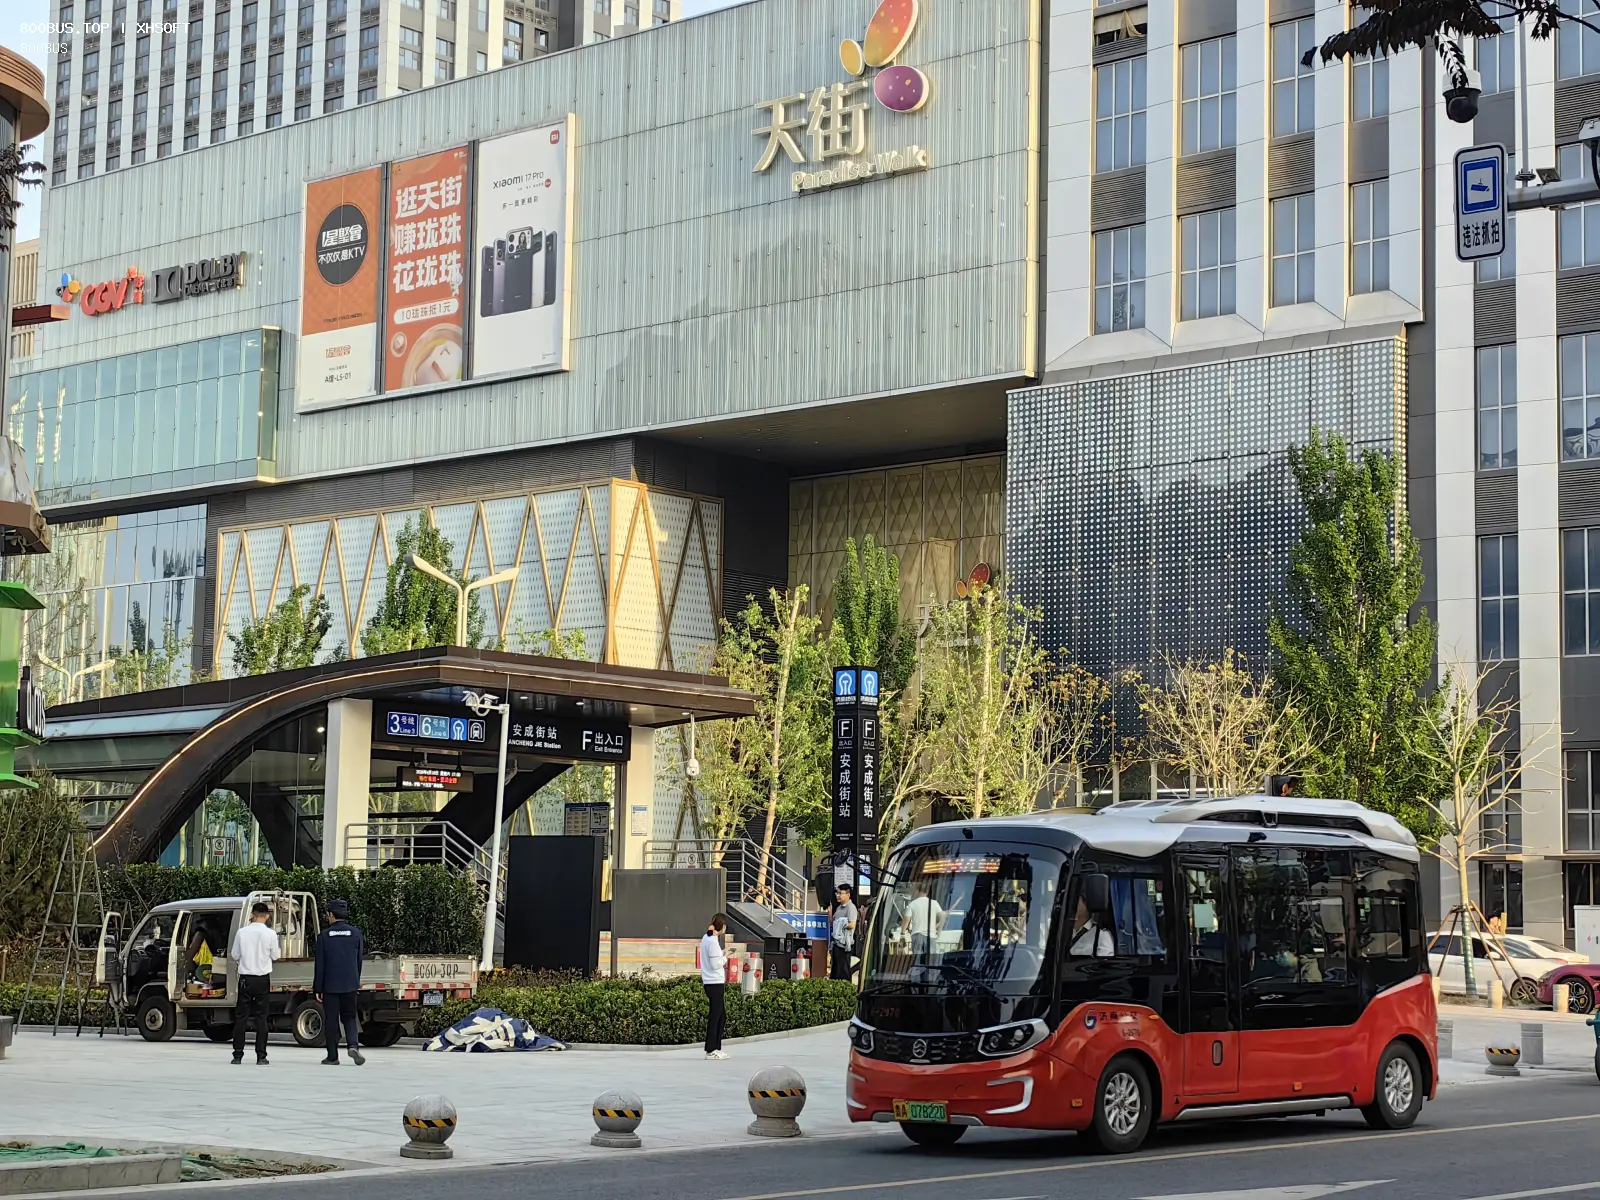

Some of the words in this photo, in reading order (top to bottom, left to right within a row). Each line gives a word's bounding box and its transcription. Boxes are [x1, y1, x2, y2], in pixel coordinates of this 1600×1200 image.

[751, 80, 870, 173] 天街
[525, 173, 532, 181] 17
[532, 171, 544, 180] Pro
[792, 159, 871, 192] Paradise
[874, 145, 927, 174] Walk
[395, 174, 462, 220] 逛天街
[394, 212, 461, 257] 赚珑珠
[1463, 219, 1499, 248] 违法抓拍
[184, 251, 247, 284] DOLBY
[318, 245, 366, 265] 不仅仅是KTV
[393, 250, 462, 293] 花珑珠
[80, 277, 128, 316] CGV
[401, 302, 451, 320] 10珑珠抵1元
[512, 724, 557, 740] 安成街站
[582, 730, 593, 750] F
[594, 732, 624, 746] 出入口
[841, 721, 850, 736] F
[865, 721, 873, 737] F
[604, 746, 623, 754] Entrance
[839, 753, 851, 818] 安成街站
[863, 753, 874, 819] 安成街站
